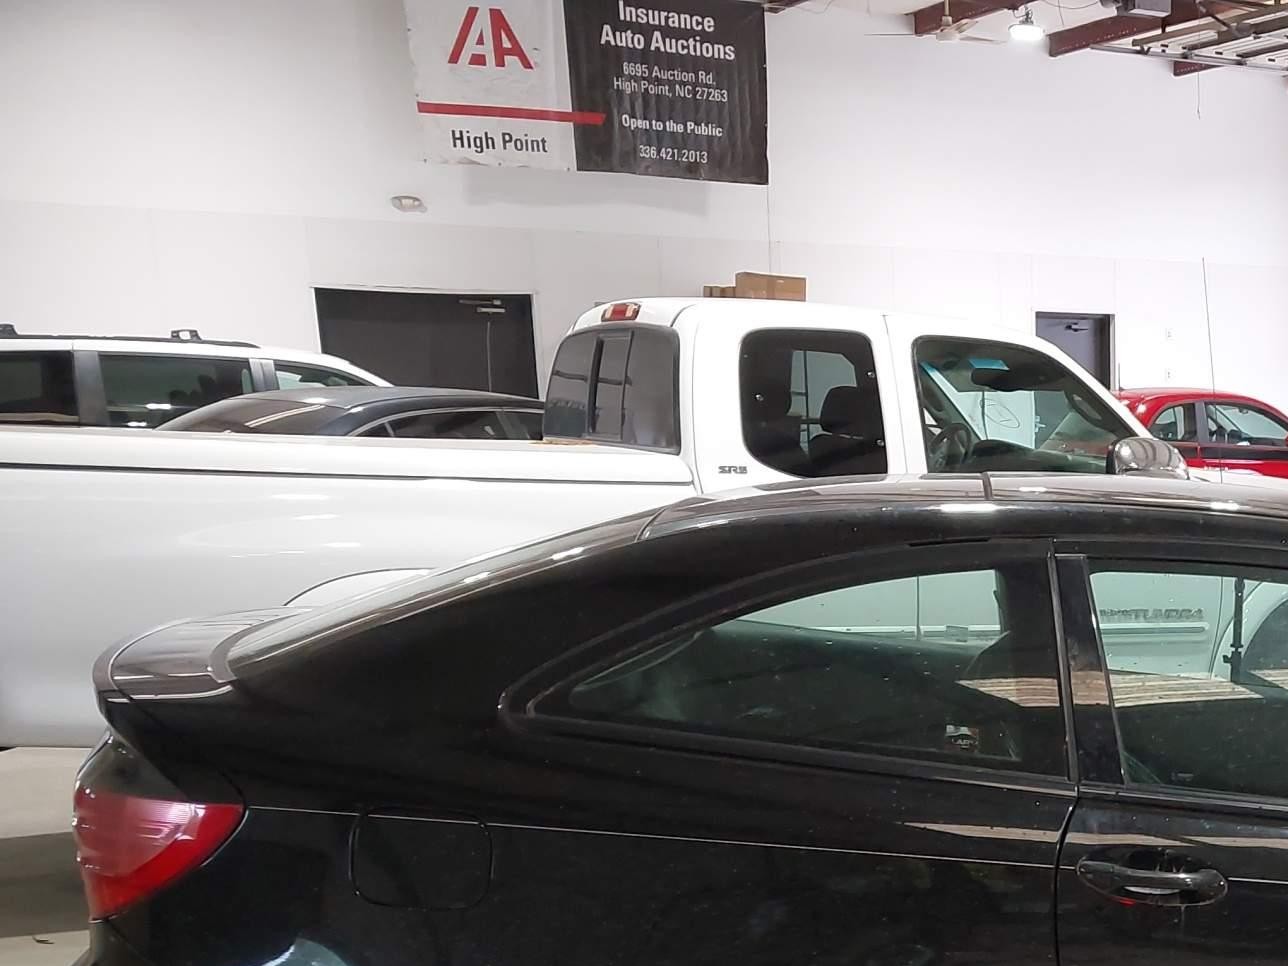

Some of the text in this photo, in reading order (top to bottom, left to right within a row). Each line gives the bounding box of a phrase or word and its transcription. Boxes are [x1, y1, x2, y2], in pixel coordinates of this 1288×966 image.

[618, 0, 716, 32] Insurance
[600, 24, 736, 61] Auto Auctions
[623, 61, 717, 85] 6695 Auction Rd.
[613, 76, 728, 102] High Point, NC 27263
[621, 113, 723, 137] Open to the Public
[451, 129, 548, 154] High Point
[639, 144, 709, 164] 336.421.2013
